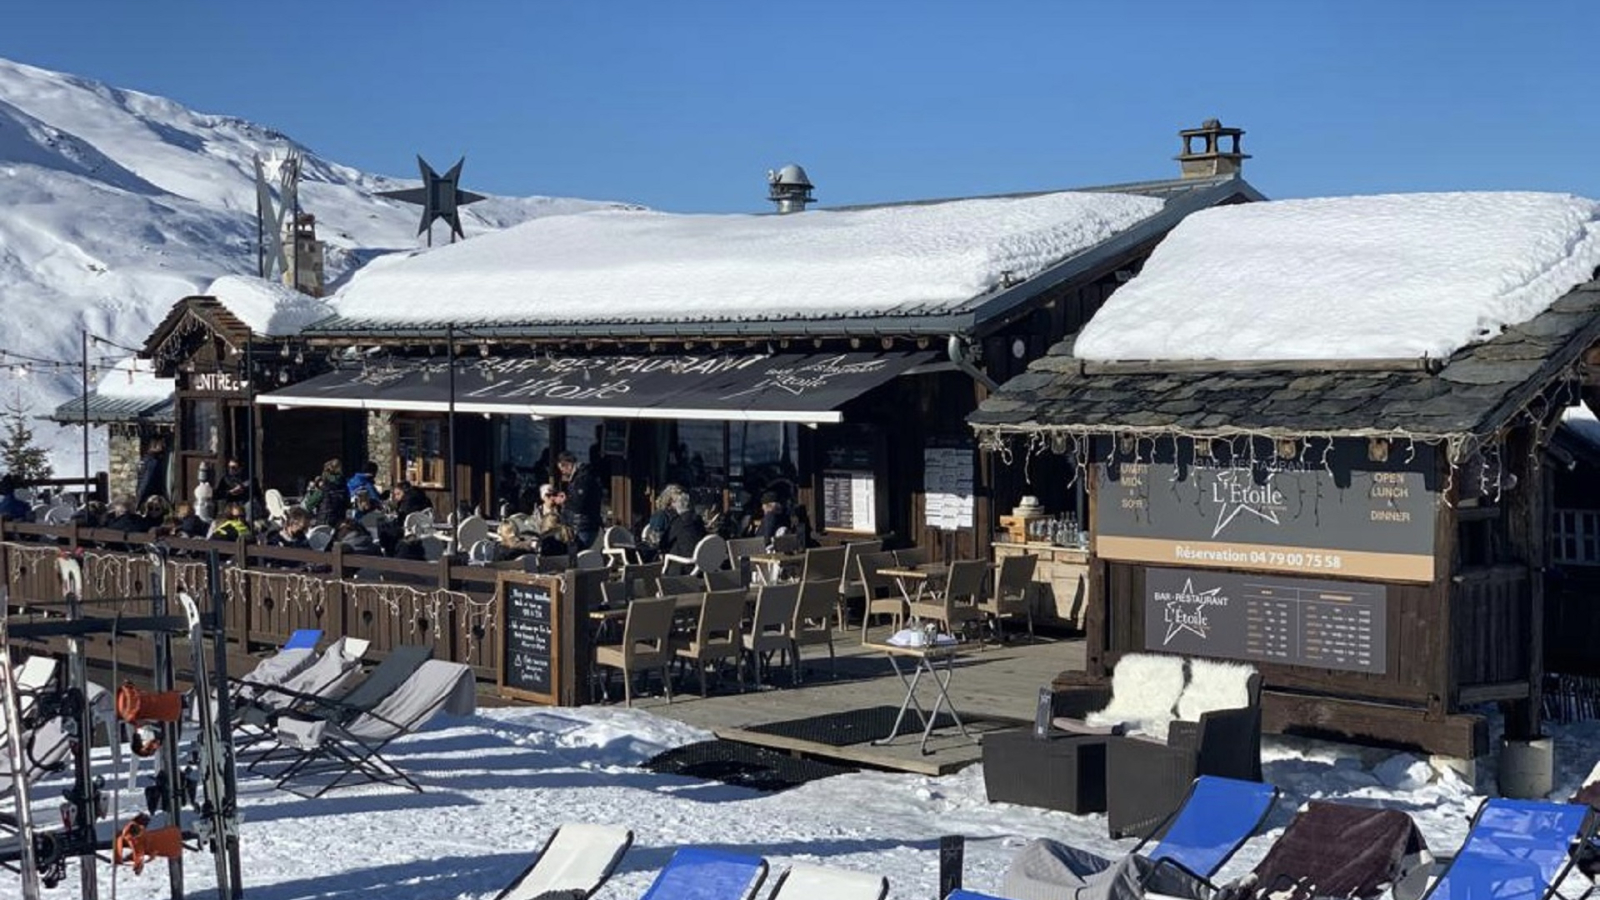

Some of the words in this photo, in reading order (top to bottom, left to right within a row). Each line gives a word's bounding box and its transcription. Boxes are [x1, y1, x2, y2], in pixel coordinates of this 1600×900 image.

[1374, 472, 1405, 484] OPEN
[1372, 486, 1408, 498] LUNCH
[1371, 510, 1411, 522] DINNER
[1175, 545, 1248, 562] Réservation
[1250, 551, 1267, 564] 04
[1269, 551, 1286, 566] 79
[1287, 553, 1303, 566] 00
[1306, 554, 1323, 568] 75
[1325, 555, 1341, 569] 58
